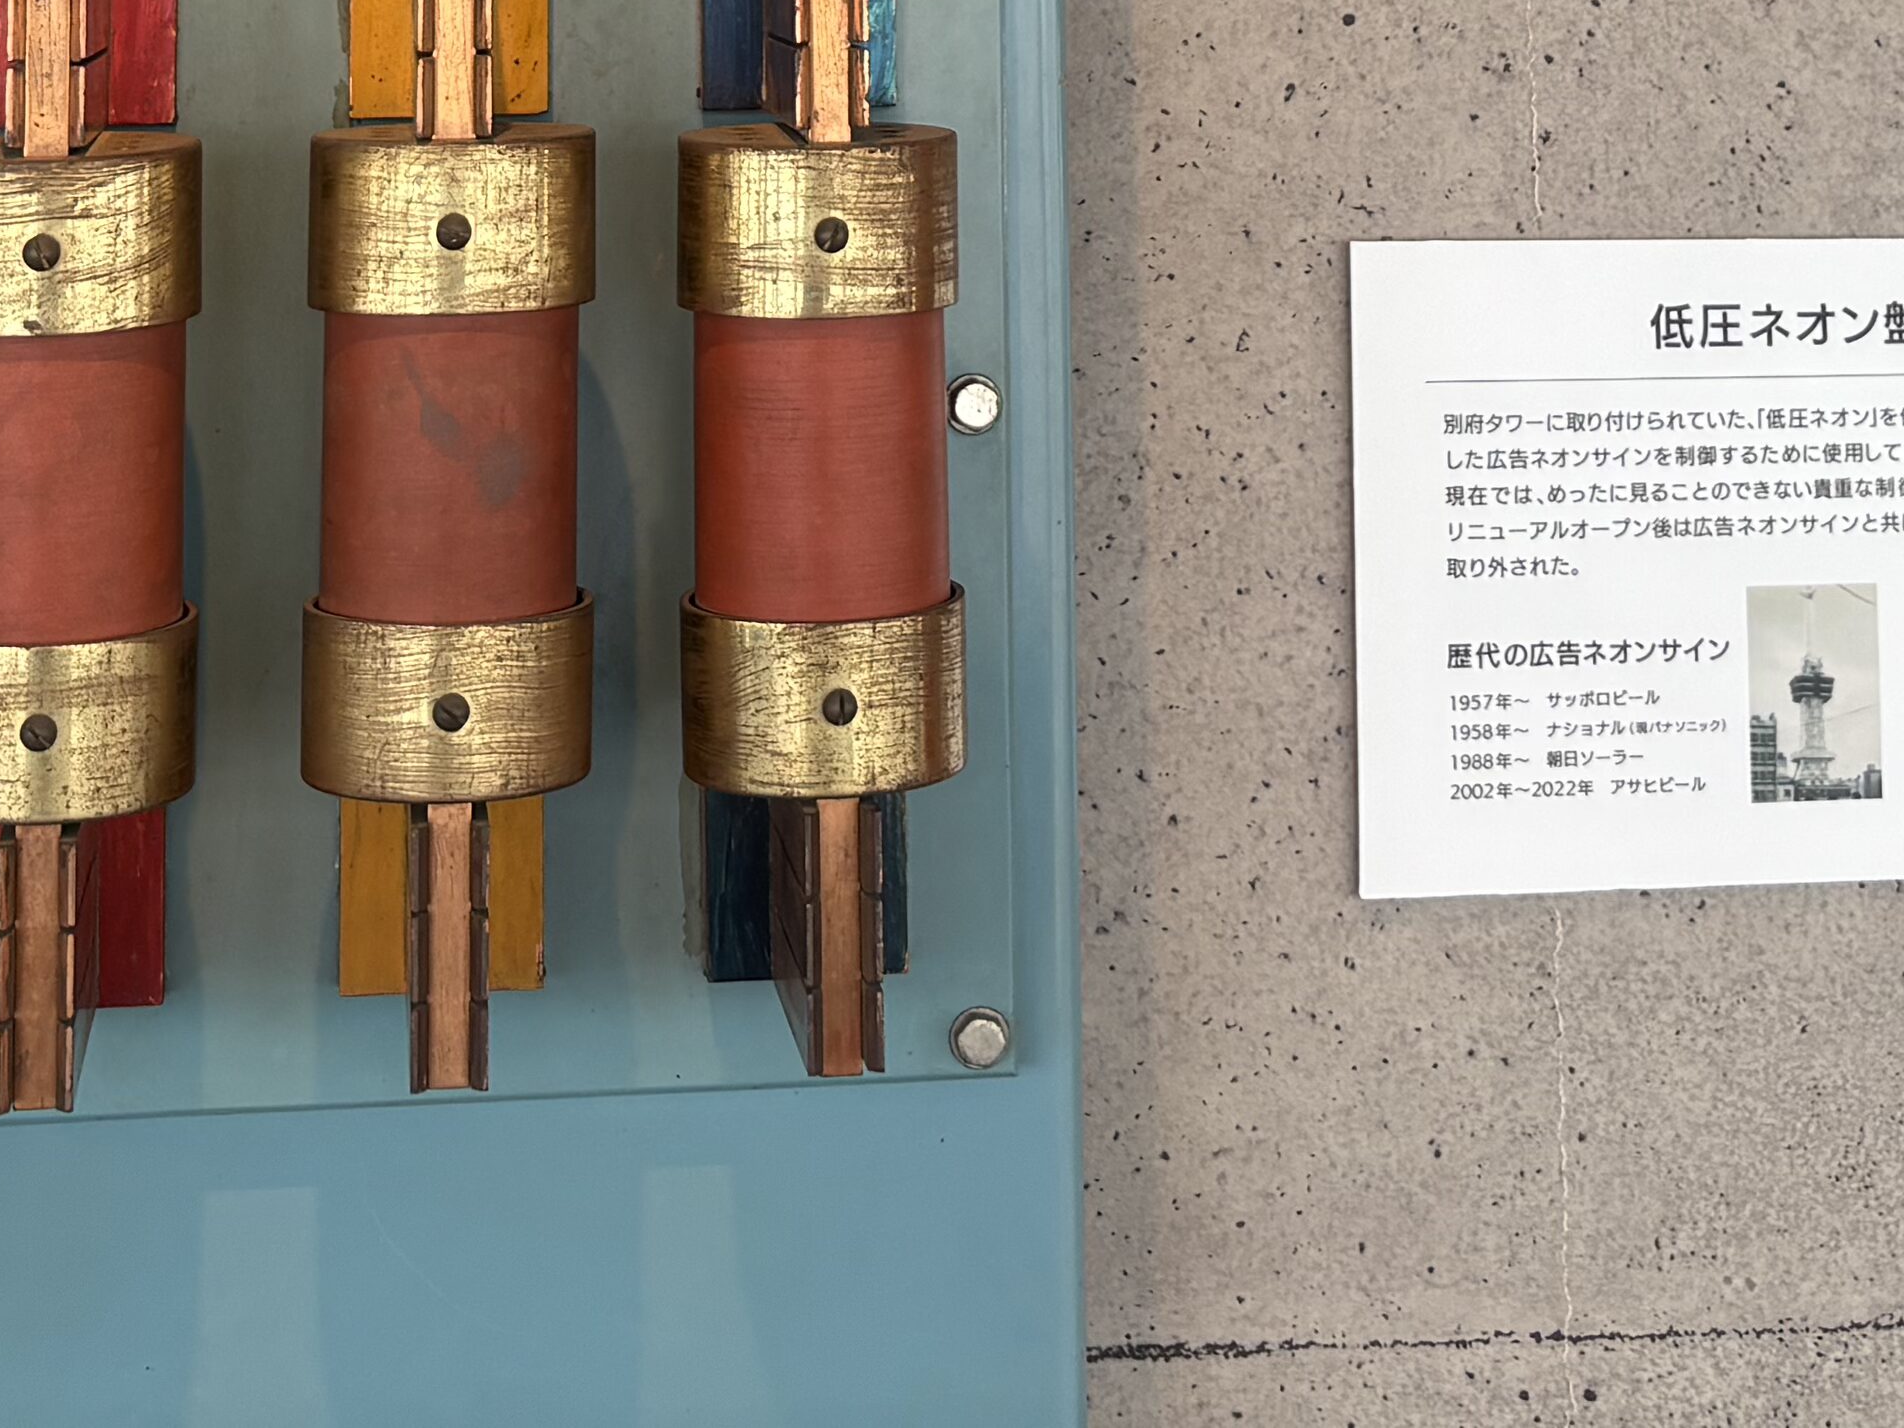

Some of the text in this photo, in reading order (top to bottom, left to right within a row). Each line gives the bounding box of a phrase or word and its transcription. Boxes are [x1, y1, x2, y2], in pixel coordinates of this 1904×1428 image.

[1445, 555, 1580, 580] 取り外された。
[1446, 637, 1730, 670] 歴代の広告ネオンサイン
[1546, 689, 1661, 709] サッポロビール
[1546, 749, 1644, 769] 朝日ソーラー
[1610, 776, 1707, 795] アサヒビール
